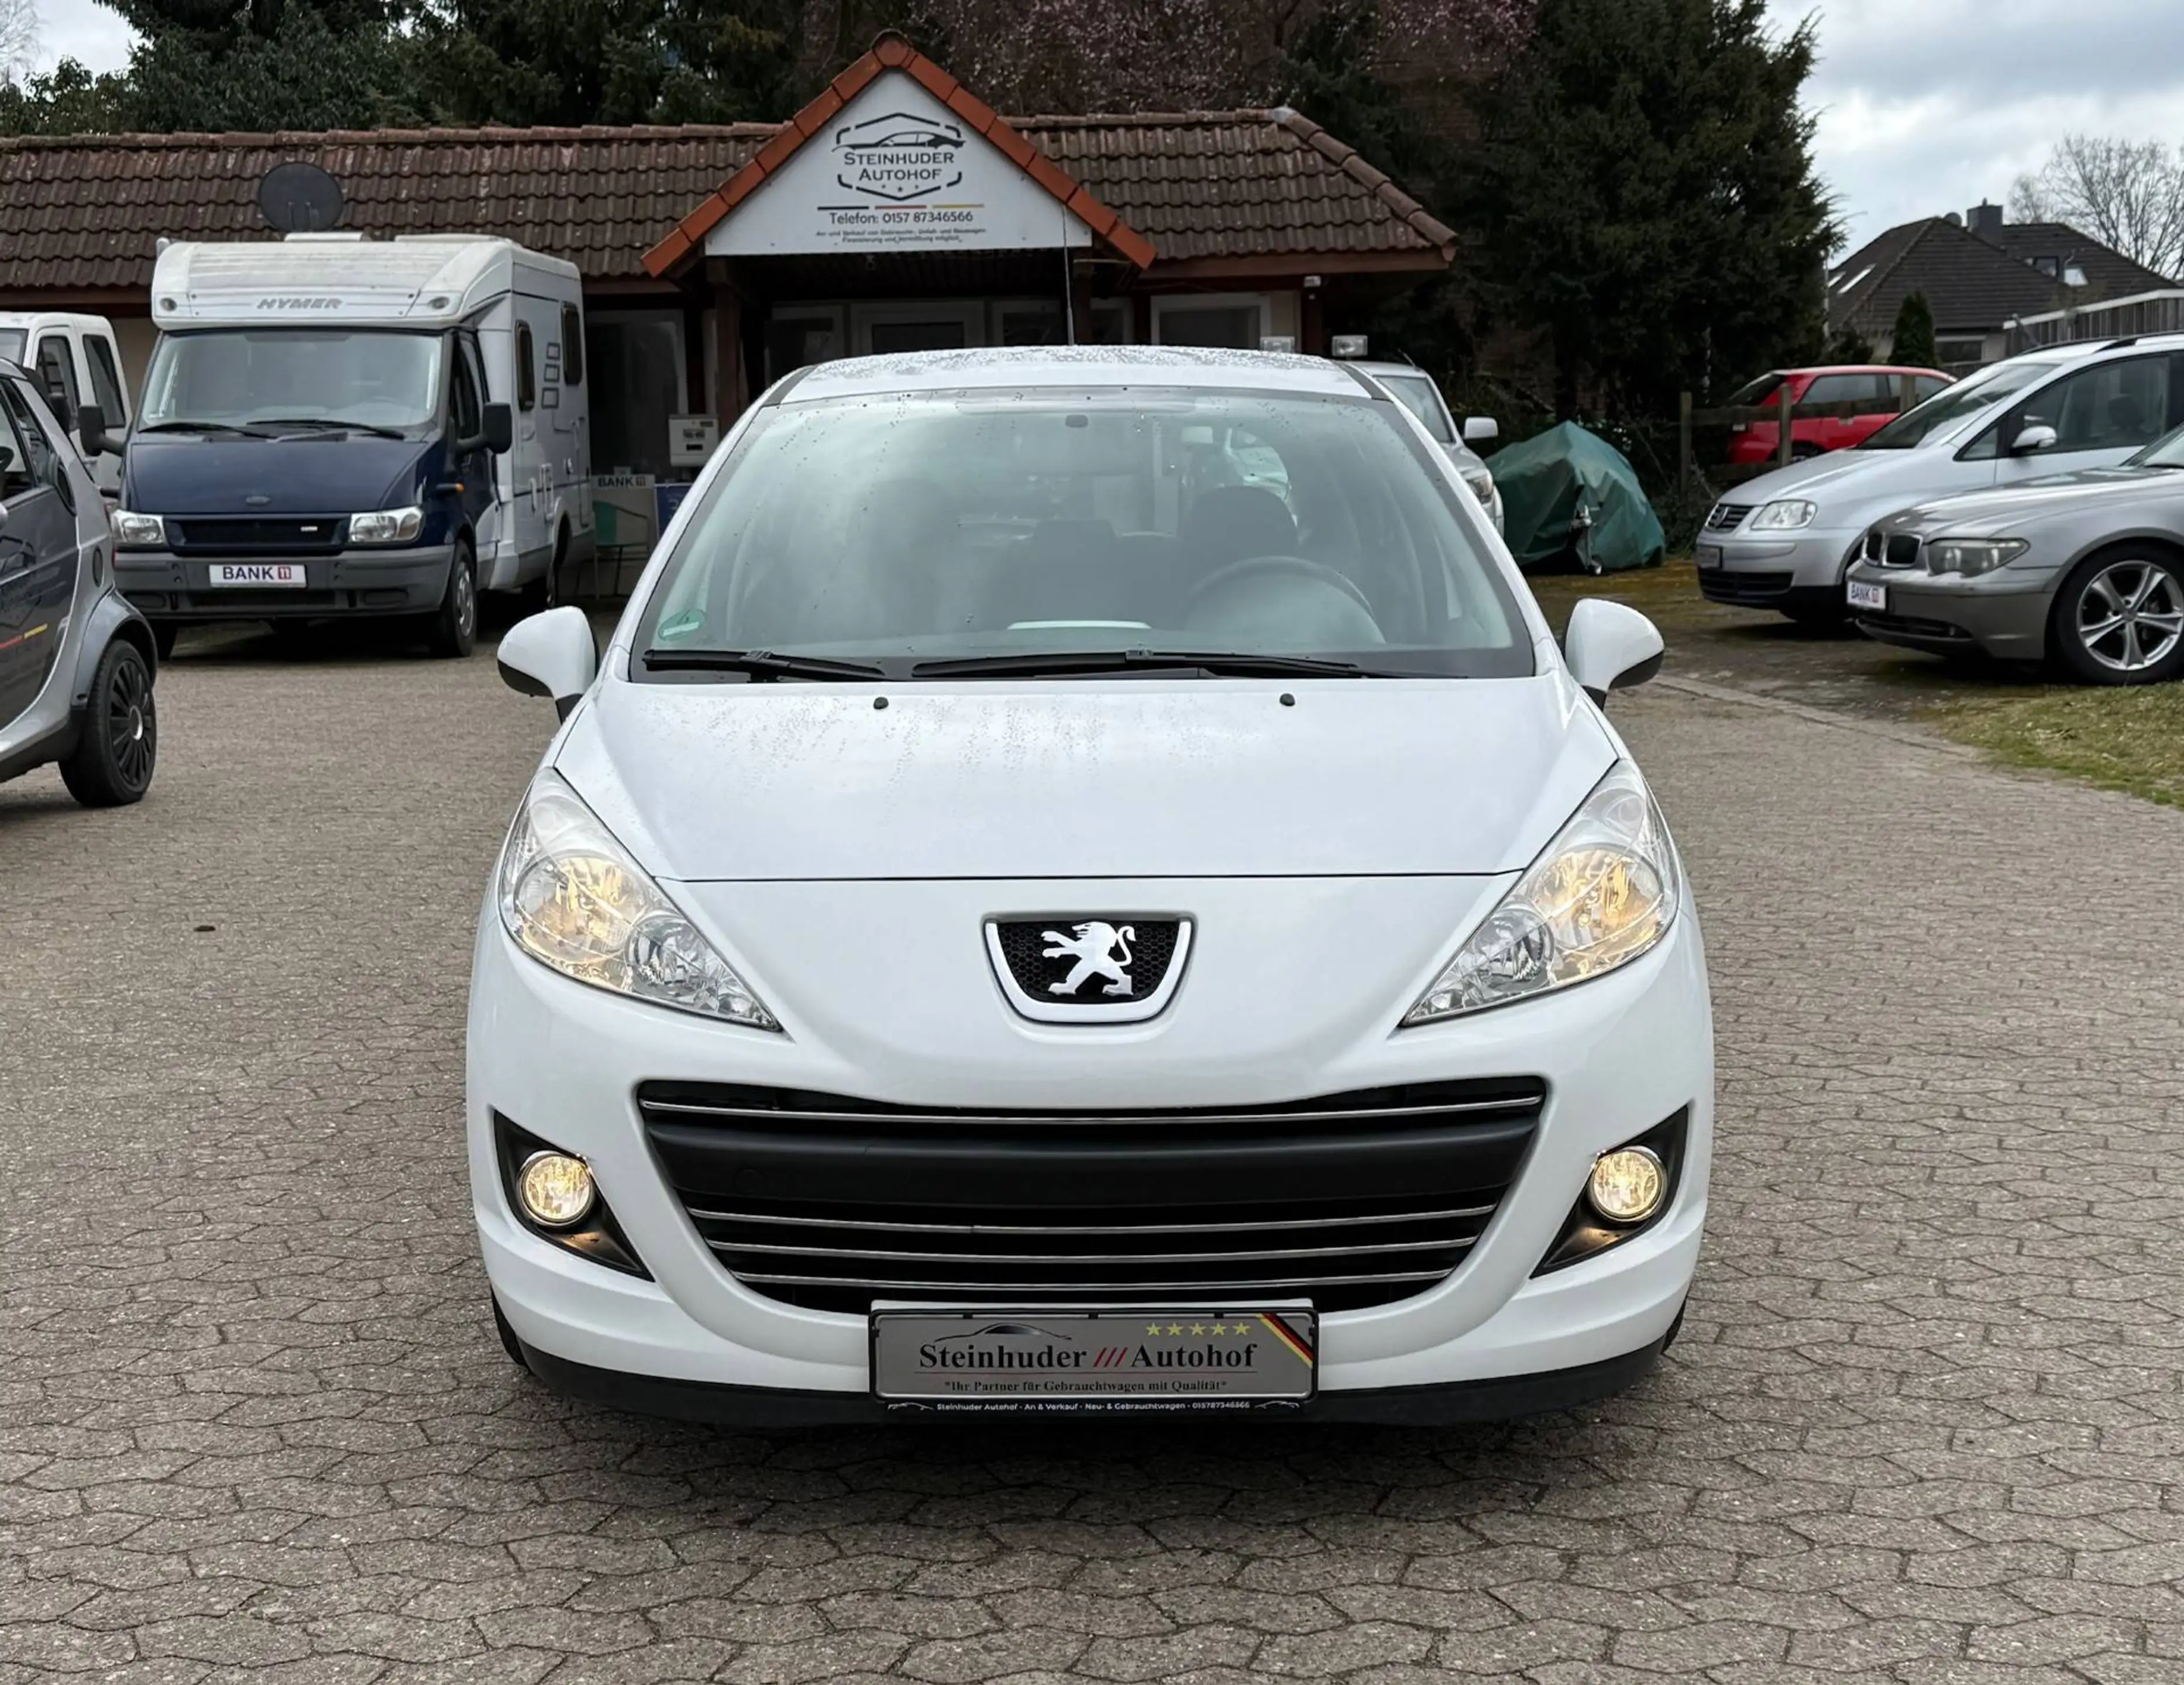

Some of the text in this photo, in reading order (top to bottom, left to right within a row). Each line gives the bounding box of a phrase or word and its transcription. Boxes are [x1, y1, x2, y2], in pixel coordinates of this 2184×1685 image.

[844, 152, 954, 166] STEINHUDER
[858, 168, 943, 181] AUTOHOF
[828, 210, 973, 225] Telefon: 0157 87346566
[256, 298, 343, 309] HYMER
[598, 476, 634, 487] BANK
[223, 566, 274, 580] BANK
[919, 1344, 1087, 1368] Steinhuder
[1131, 1343, 1257, 1368] Autohof
[975, 1381, 1019, 1391] Partner
[1023, 1381, 1041, 1391] für
[1044, 1381, 1144, 1392] Gebrauchtwagen
[1149, 1381, 1167, 1391] mit
[1115, 1403, 1186, 1411] Gebrauchtwagen
